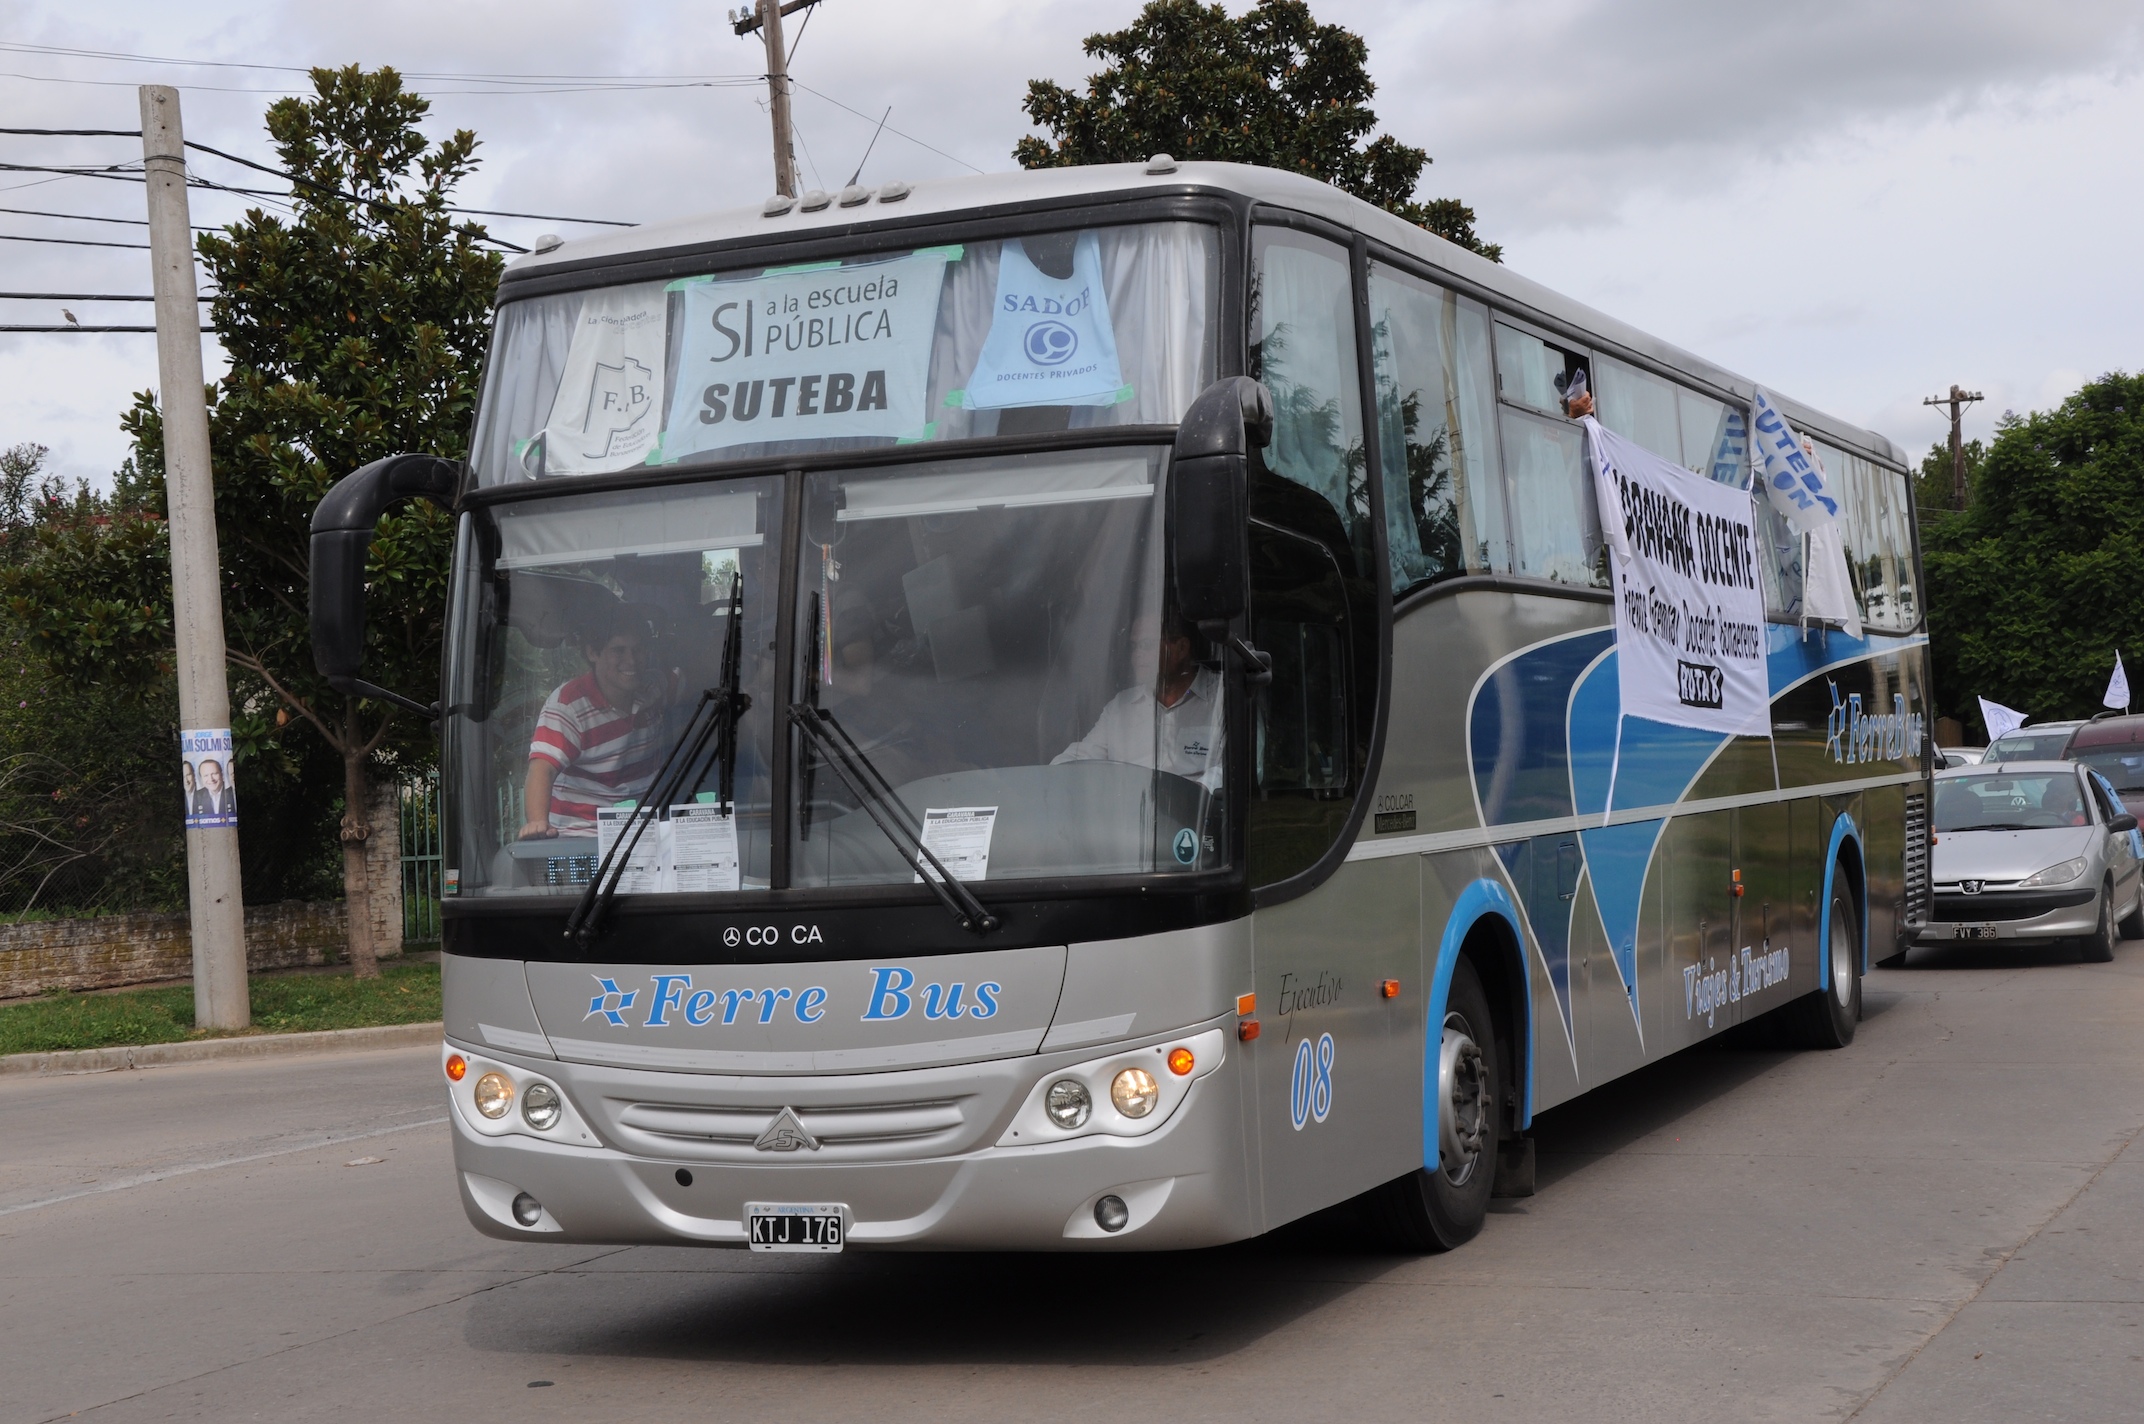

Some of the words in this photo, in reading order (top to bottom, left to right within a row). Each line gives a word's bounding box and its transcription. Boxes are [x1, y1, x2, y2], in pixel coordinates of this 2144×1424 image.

[767, 299, 777, 316] a
[783, 293, 799, 313] la
[807, 274, 898, 309] escuela
[1003, 286, 1090, 316] SADOP
[710, 299, 752, 363] SI
[765, 308, 892, 355] PÚBLICA
[997, 371, 1045, 382] DOCENTES
[1050, 363, 1098, 379] PRIVADOS
[700, 370, 888, 425] SUTEBA
[1613, 469, 1698, 581] ARAVANA
[1697, 511, 1754, 590] DOCENTE
[1683, 599, 1717, 657] Docente
[1680, 664, 1710, 702] RUTA
[195, 738, 222, 752] SOLMI
[1384, 794, 1413, 811] COLCAR
[746, 926, 779, 945] CO
[791, 925, 823, 944] CA
[1953, 927, 1971, 939] FVY
[1977, 927, 1994, 939] 386
[643, 973, 828, 1027] Ferre
[860, 966, 1002, 1022] Bus
[1683, 957, 1727, 1028] Viajes
[1729, 954, 1741, 1004] &
[1741, 941, 1790, 996] Turismo
[1279, 971, 1343, 1044] Ejecutivo
[1291, 1032, 1335, 1131] 08
[752, 1217, 789, 1243] KTJ
[802, 1217, 839, 1243] 176
